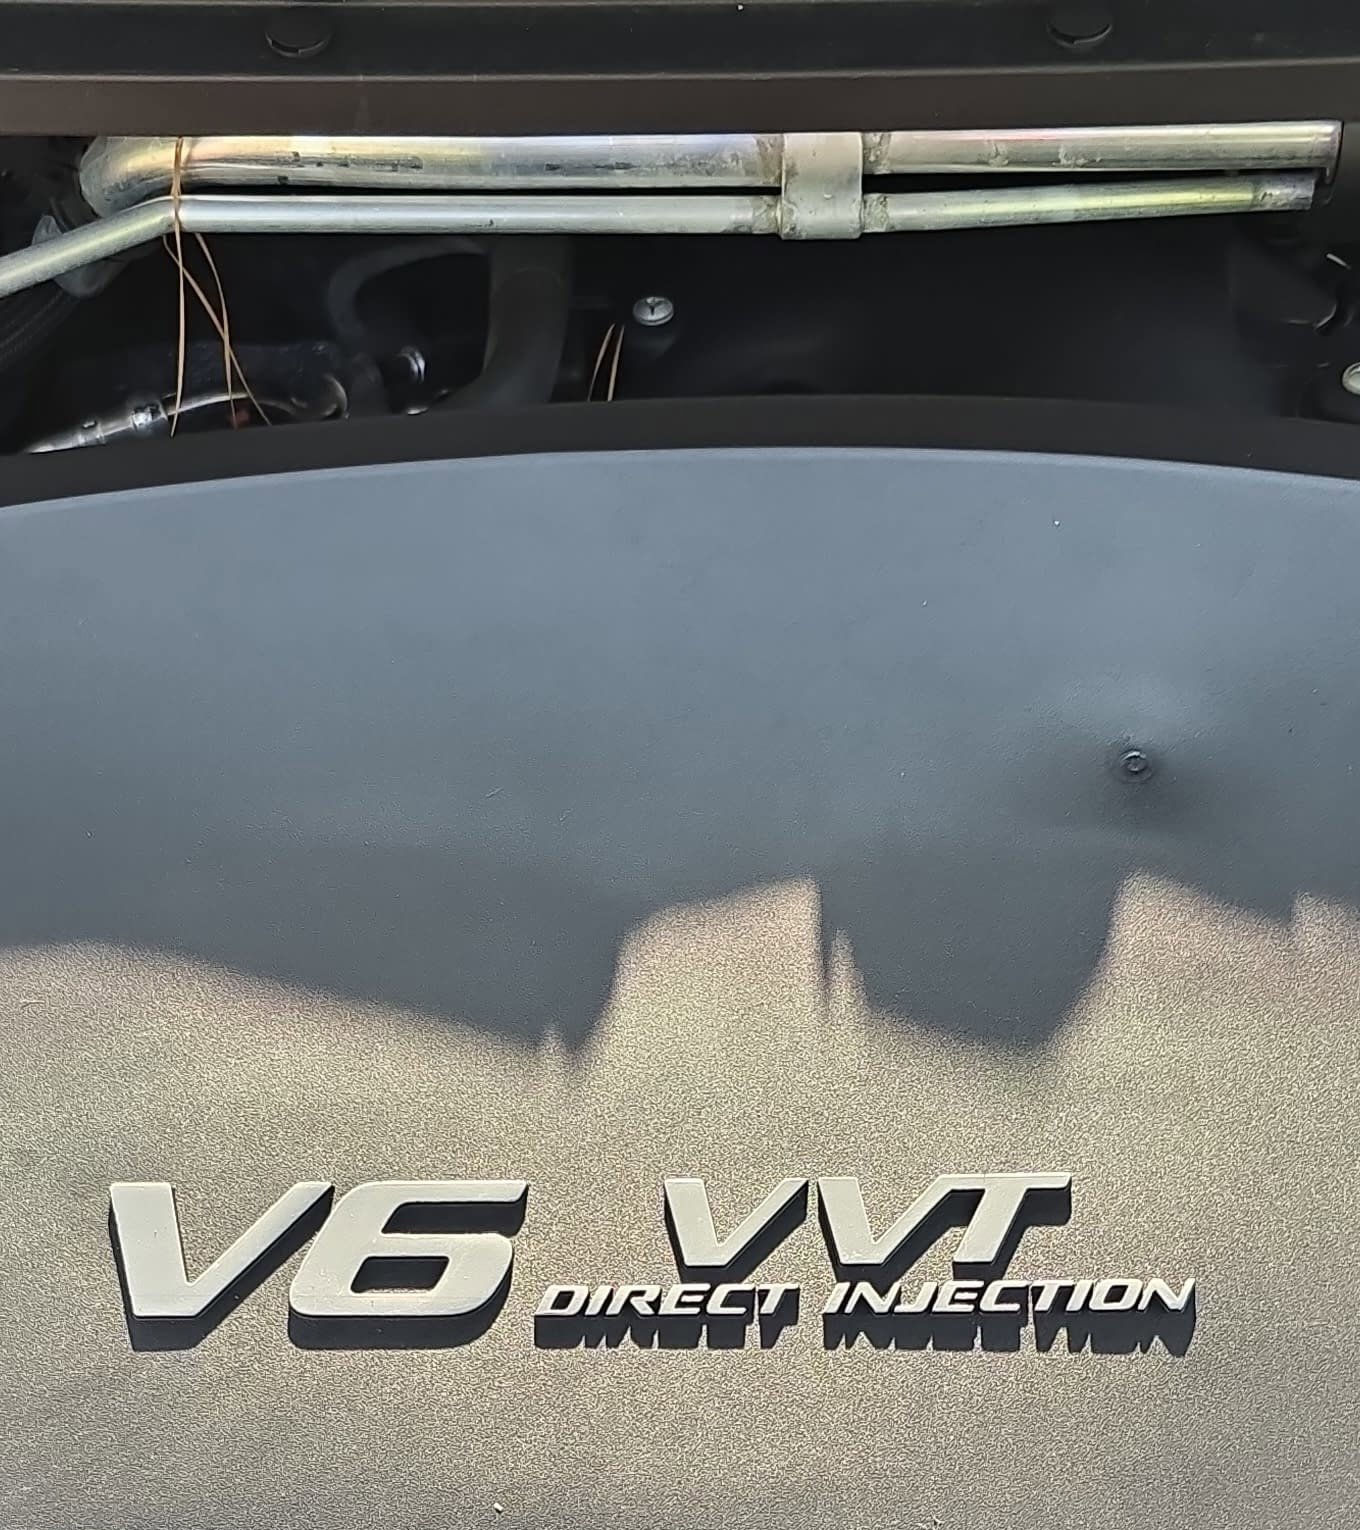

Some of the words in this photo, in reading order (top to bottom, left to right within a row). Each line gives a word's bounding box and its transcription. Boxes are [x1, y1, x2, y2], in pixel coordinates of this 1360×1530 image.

[109, 1179, 529, 1320] V6
[663, 1173, 1073, 1268] VVT
[535, 1281, 801, 1318] DIRECT
[823, 1278, 1197, 1318] INJECTION
